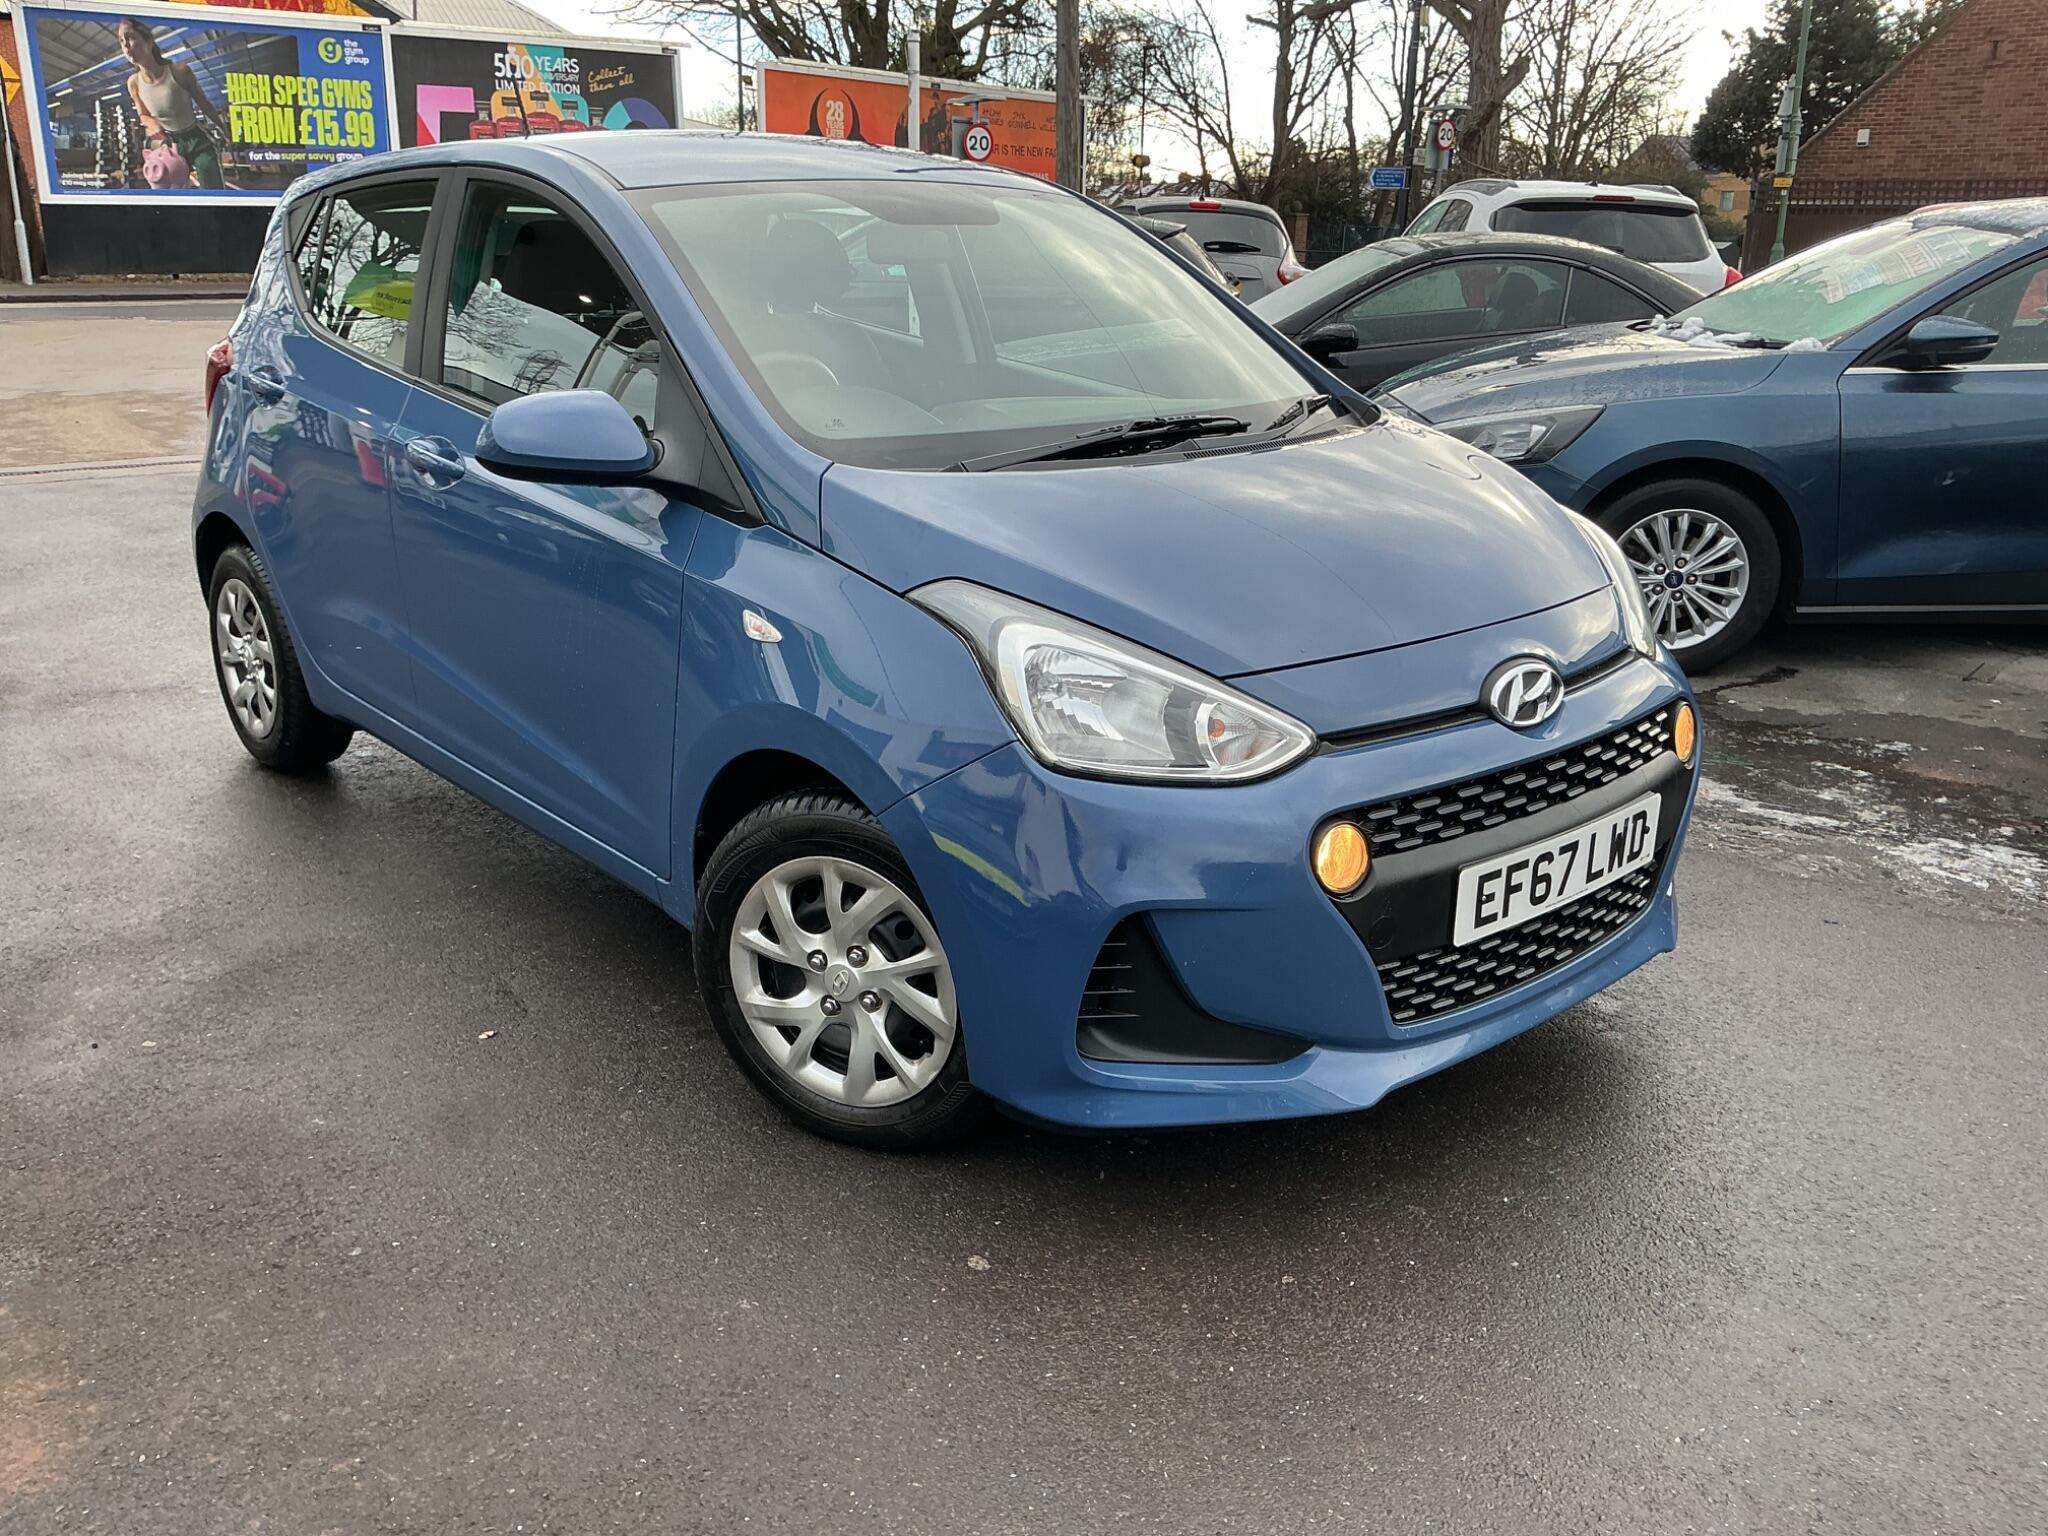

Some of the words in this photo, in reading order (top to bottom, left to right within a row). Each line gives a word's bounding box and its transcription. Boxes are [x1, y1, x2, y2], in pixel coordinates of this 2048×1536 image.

[344, 38, 358, 47] the
[344, 47, 363, 56] gym
[345, 55, 370, 66] group
[535, 56, 580, 73] YEARS
[588, 66, 626, 83] Collect
[588, 82, 615, 93] them
[619, 73, 636, 86] all
[226, 72, 272, 105] HIGH
[273, 74, 319, 107] SPEC
[321, 78, 373, 110] GYMS
[495, 80, 536, 93] LIMTED
[540, 81, 580, 95] EDITION
[826, 99, 844, 120] 28
[228, 105, 297, 145] FROM
[298, 108, 376, 148] £15.99
[1440, 128, 1453, 141] 20
[968, 135, 990, 152] 20
[1001, 144, 1009, 156] IS
[1010, 145, 1026, 157] THE
[1026, 146, 1043, 158] NEW
[249, 151, 264, 161] for
[265, 151, 280, 160] the
[281, 152, 306, 162] super
[308, 152, 335, 162] savvy
[1474, 840, 1580, 930] EF67
[1586, 810, 1650, 885] LWD
